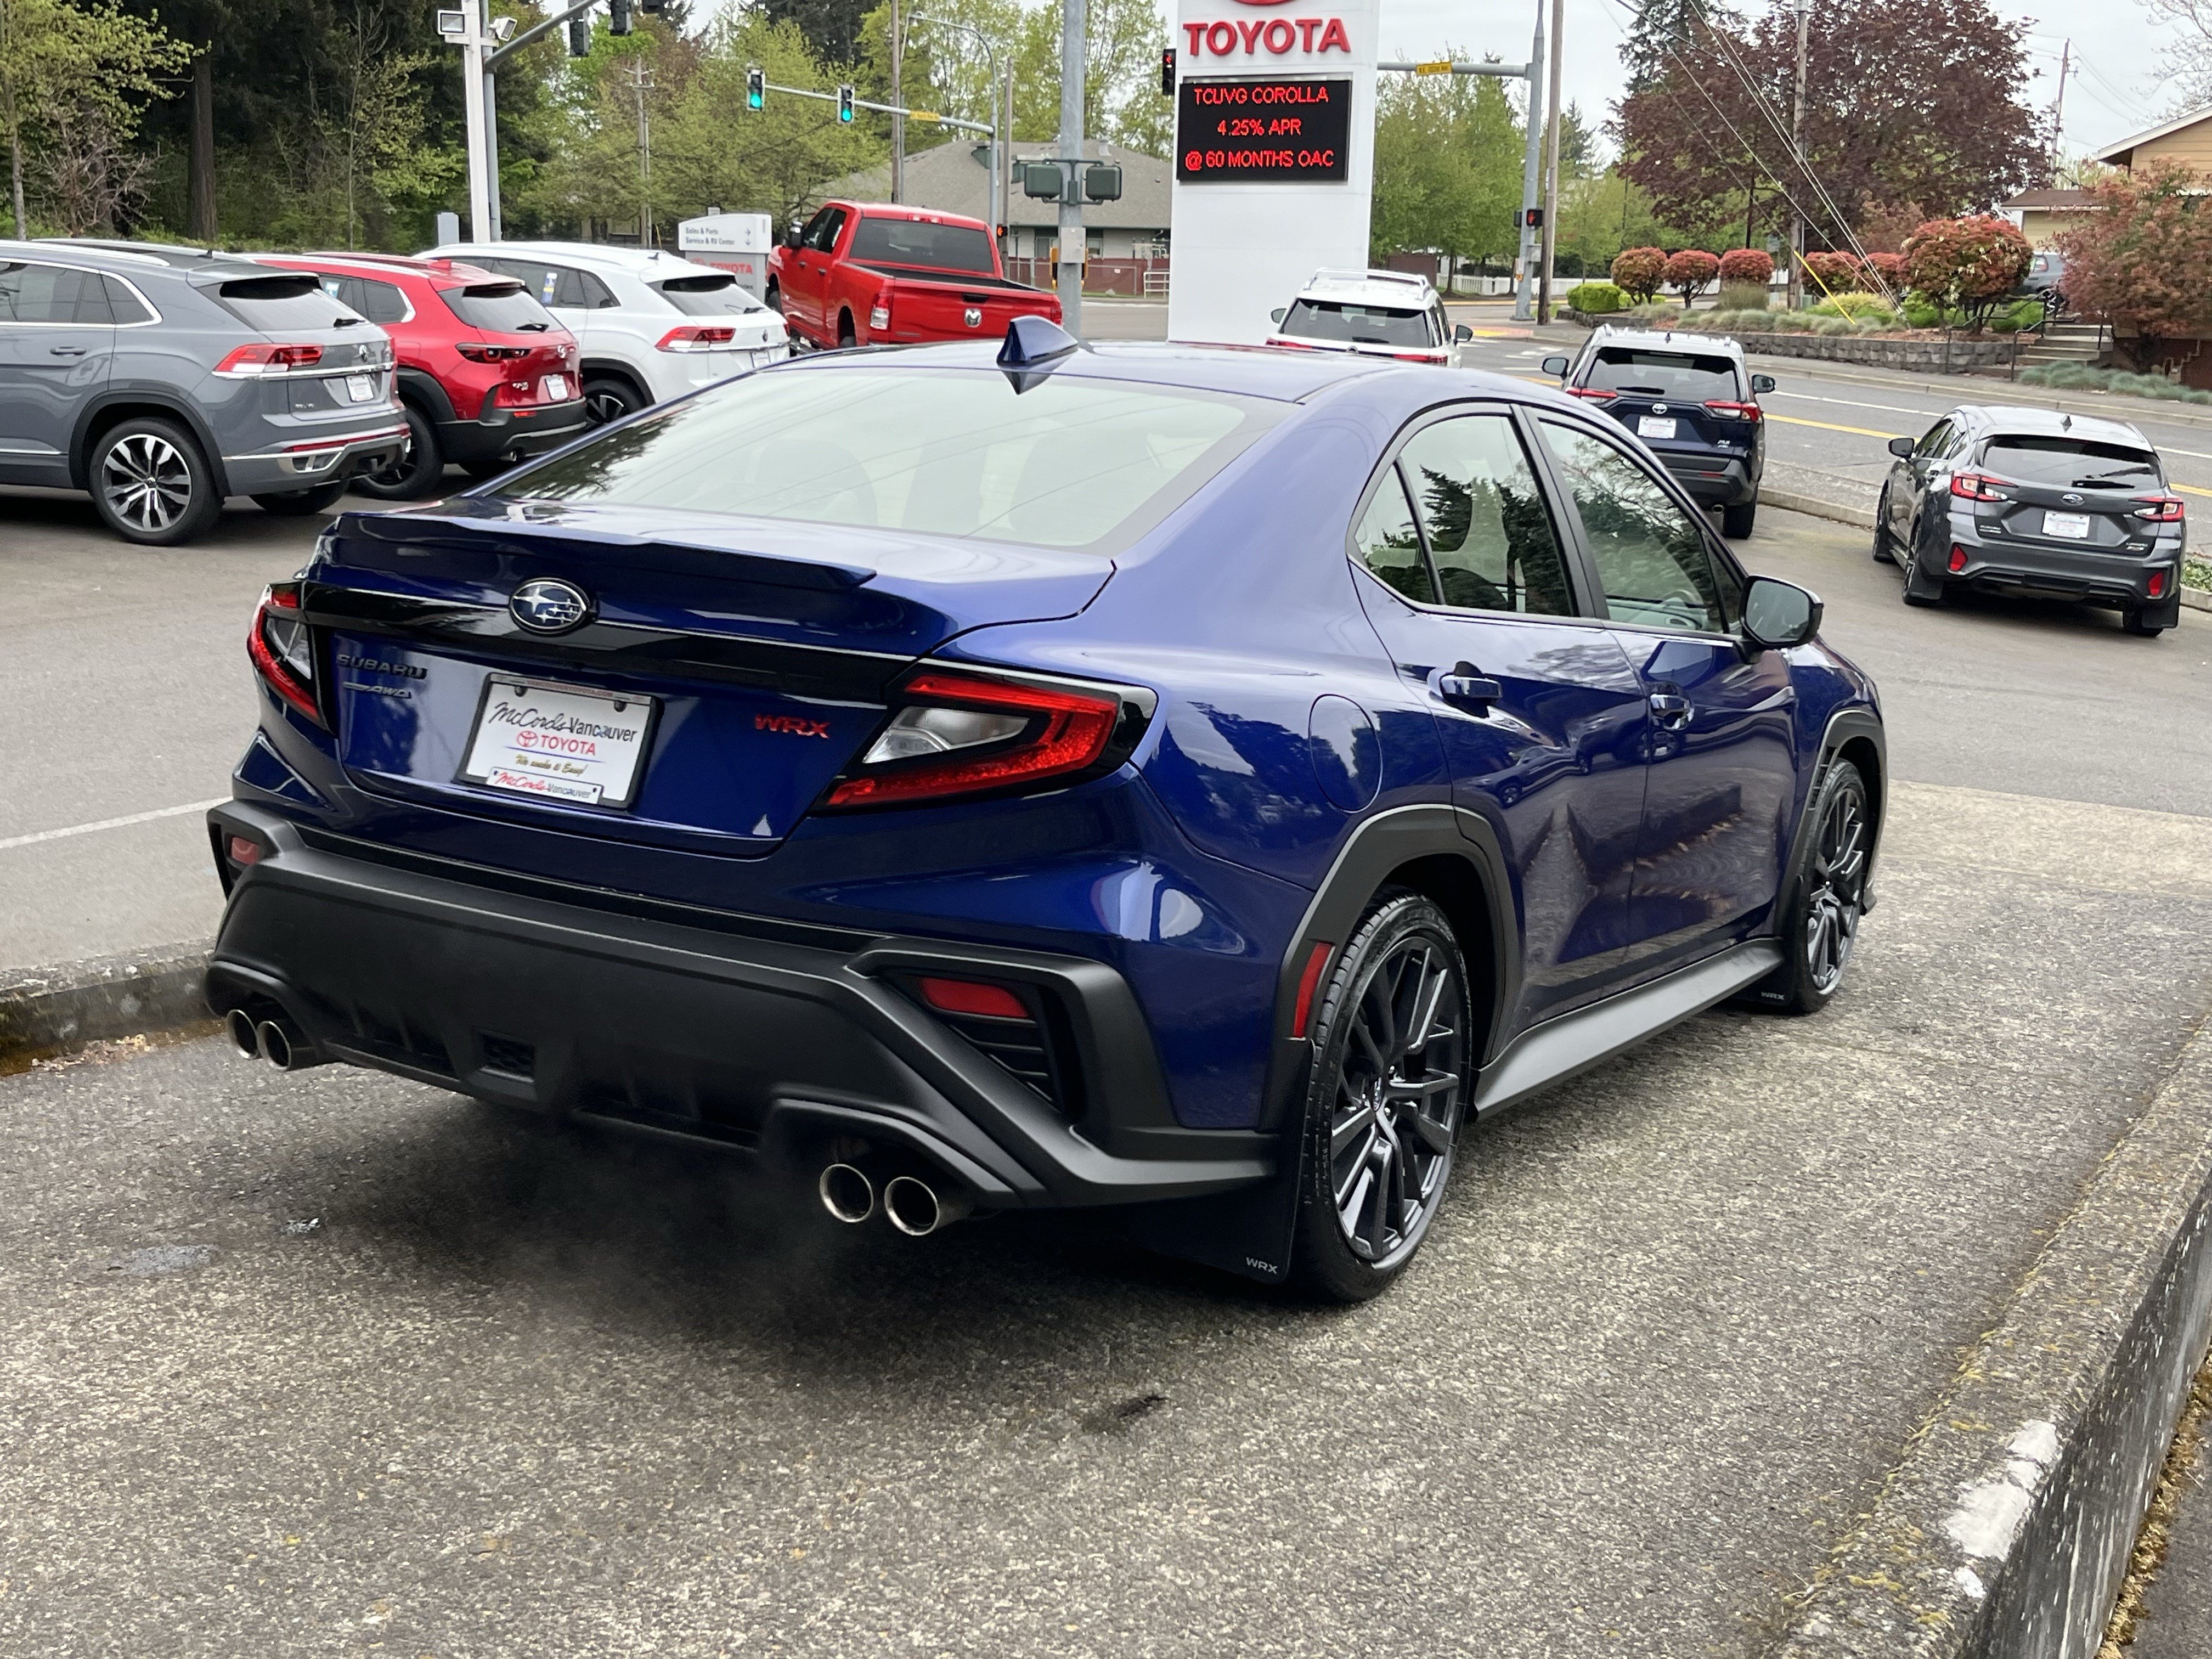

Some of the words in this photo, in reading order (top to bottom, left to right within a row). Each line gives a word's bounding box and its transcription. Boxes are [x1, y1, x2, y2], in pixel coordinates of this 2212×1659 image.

[1183, 18, 1351, 56] TOYOTA
[1193, 87, 1248, 105] TCUVG
[1252, 87, 1329, 104] COROLLA
[1217, 119, 1265, 136] 4.25%
[1268, 119, 1302, 136] APR
[1185, 151, 1203, 171] @
[1206, 150, 1224, 167] 60
[1228, 150, 1294, 167] MONTHS
[1298, 150, 1335, 167] OAC
[336, 654, 428, 679] SUBARU
[366, 685, 413, 699] AWD
[754, 713, 831, 739] WRX
[541, 735, 596, 755] TOYOTA
[1761, 991, 1784, 1000] WRX
[1246, 1257, 1278, 1274] WRX
